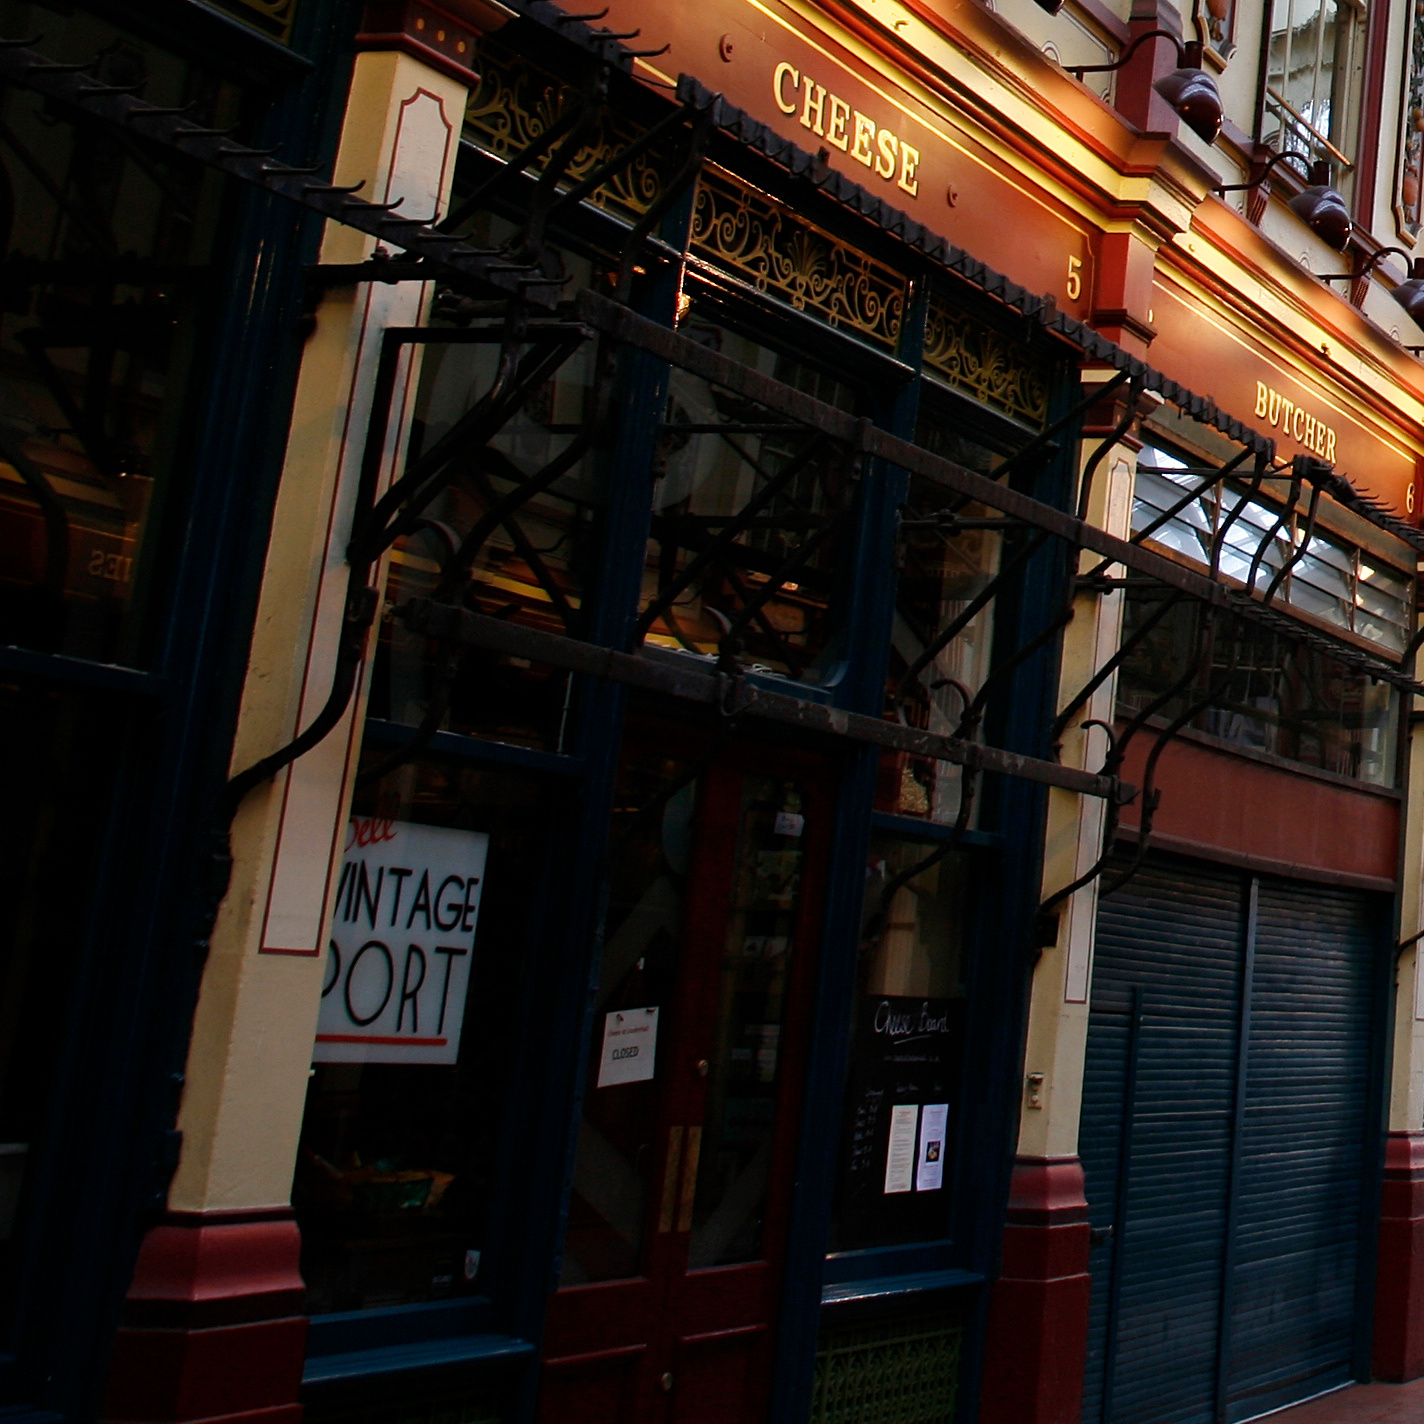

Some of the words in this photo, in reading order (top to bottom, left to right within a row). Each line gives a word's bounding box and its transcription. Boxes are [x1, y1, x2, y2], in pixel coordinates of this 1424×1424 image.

[773, 61, 921, 197] CHEESE
[1066, 254, 1083, 301] 5
[1255, 380, 1337, 465] BUTCHER
[1406, 482, 1415, 514] 6
[334, 859, 480, 932] VINTAGE
